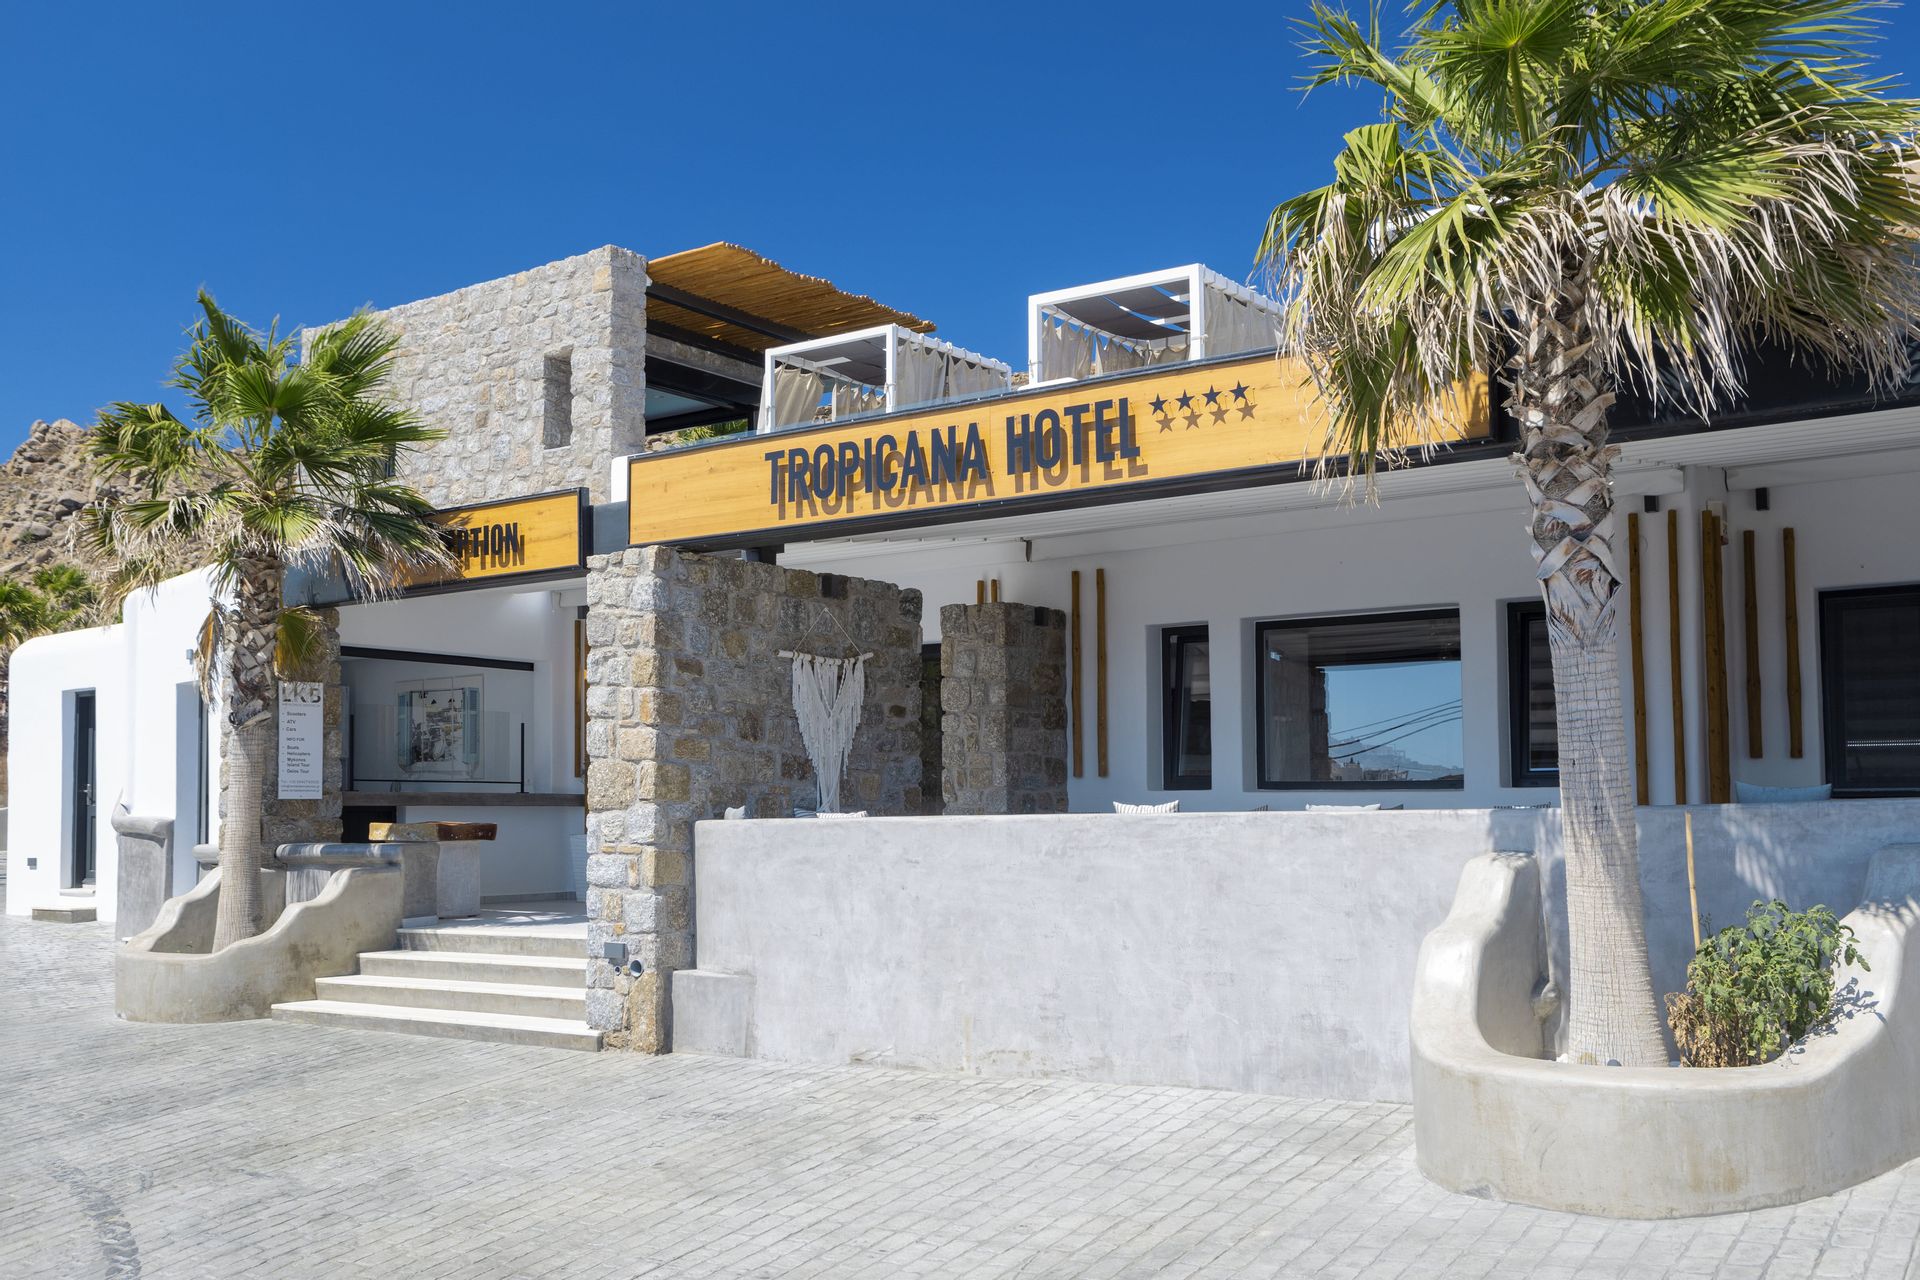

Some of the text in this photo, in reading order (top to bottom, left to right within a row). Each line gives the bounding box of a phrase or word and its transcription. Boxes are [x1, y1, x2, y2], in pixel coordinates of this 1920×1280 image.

[764, 397, 1141, 504] TROPICANA HOTEL
[457, 522, 518, 558] PTION
